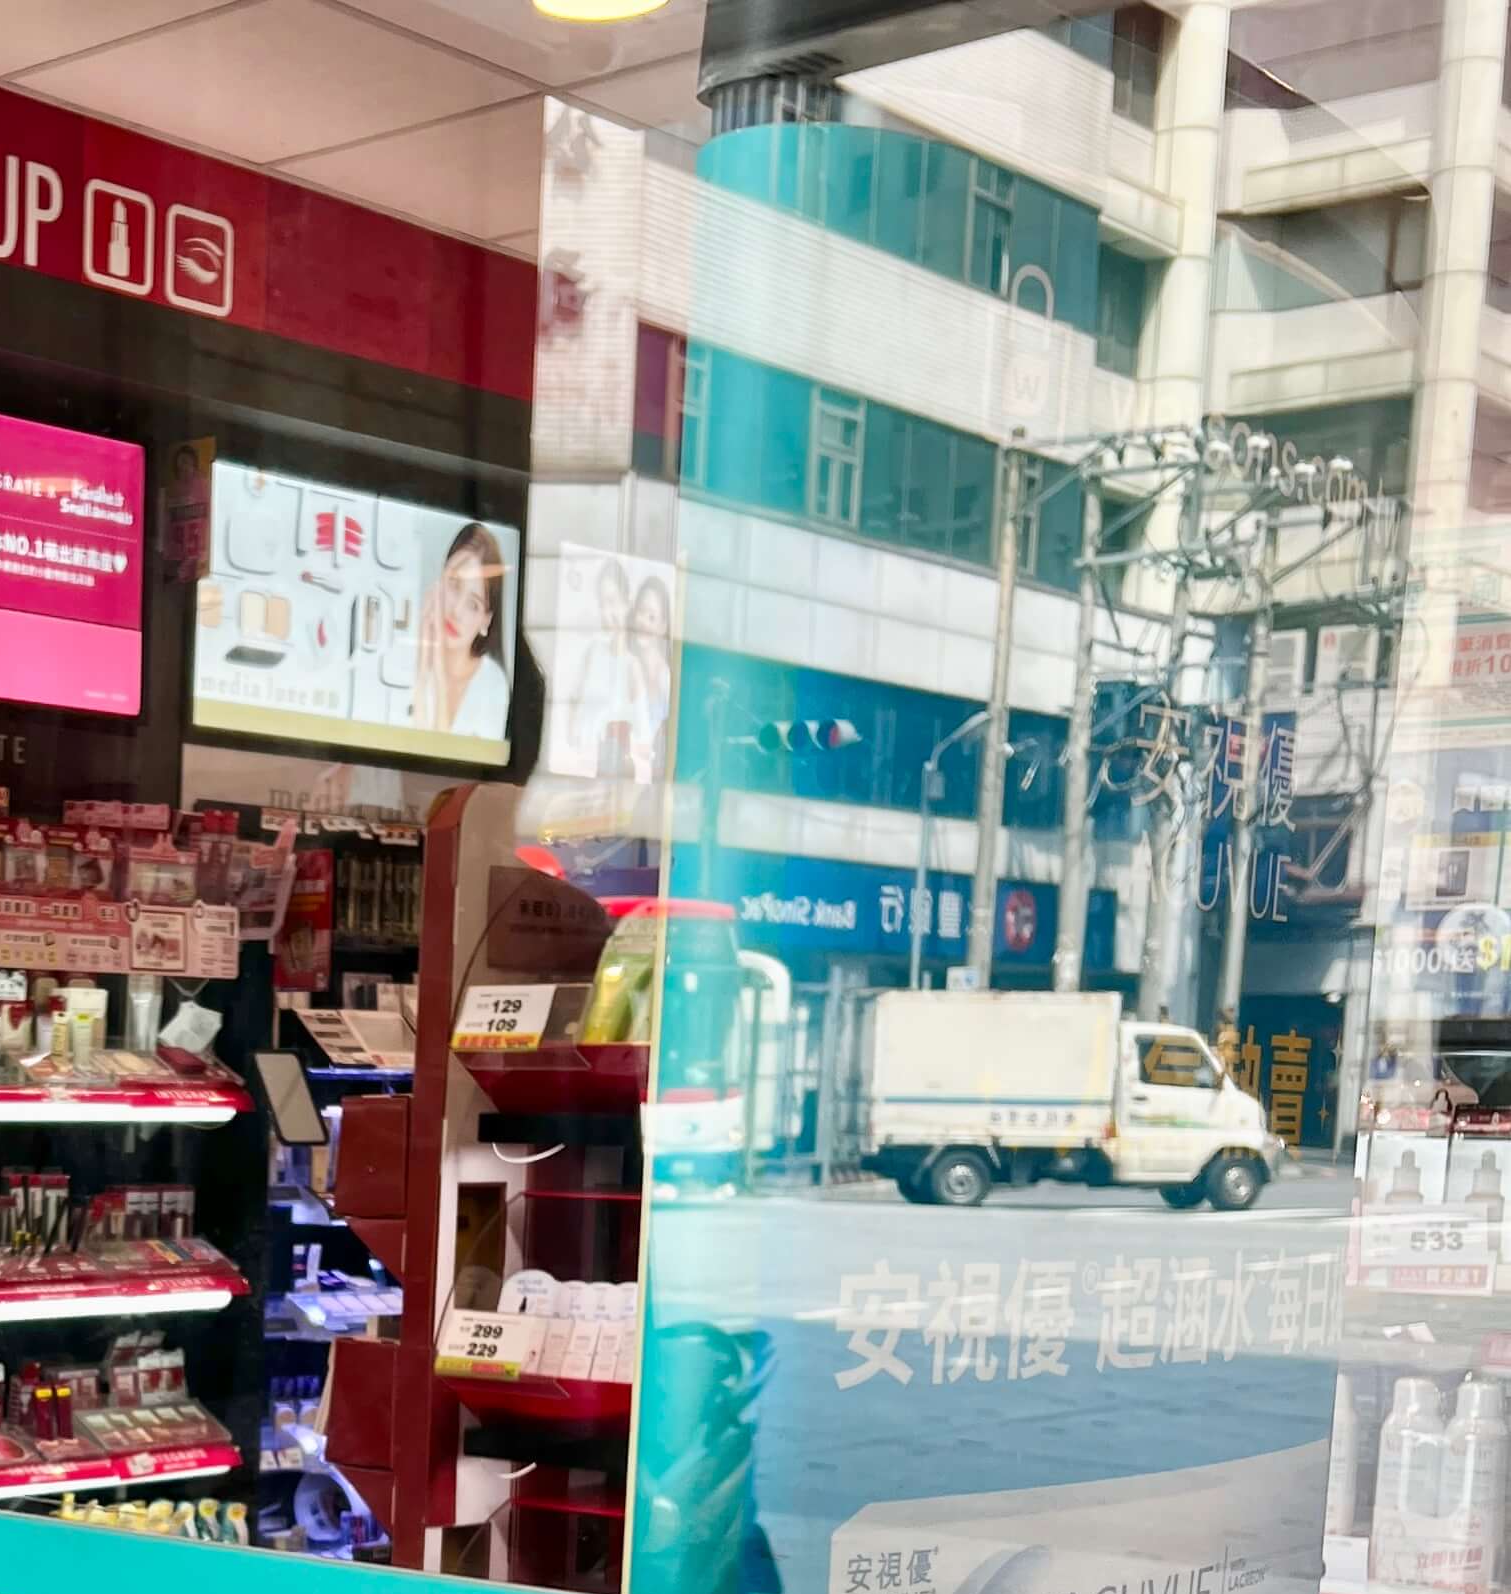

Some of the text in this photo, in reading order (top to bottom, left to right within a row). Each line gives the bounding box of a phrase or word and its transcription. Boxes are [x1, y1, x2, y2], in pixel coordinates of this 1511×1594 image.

[492, 999, 522, 1014] 129
[486, 1018, 517, 1033] 109
[1411, 1231, 1464, 1251] 533
[472, 1324, 503, 1339] 299
[465, 1342, 498, 1358] 229
